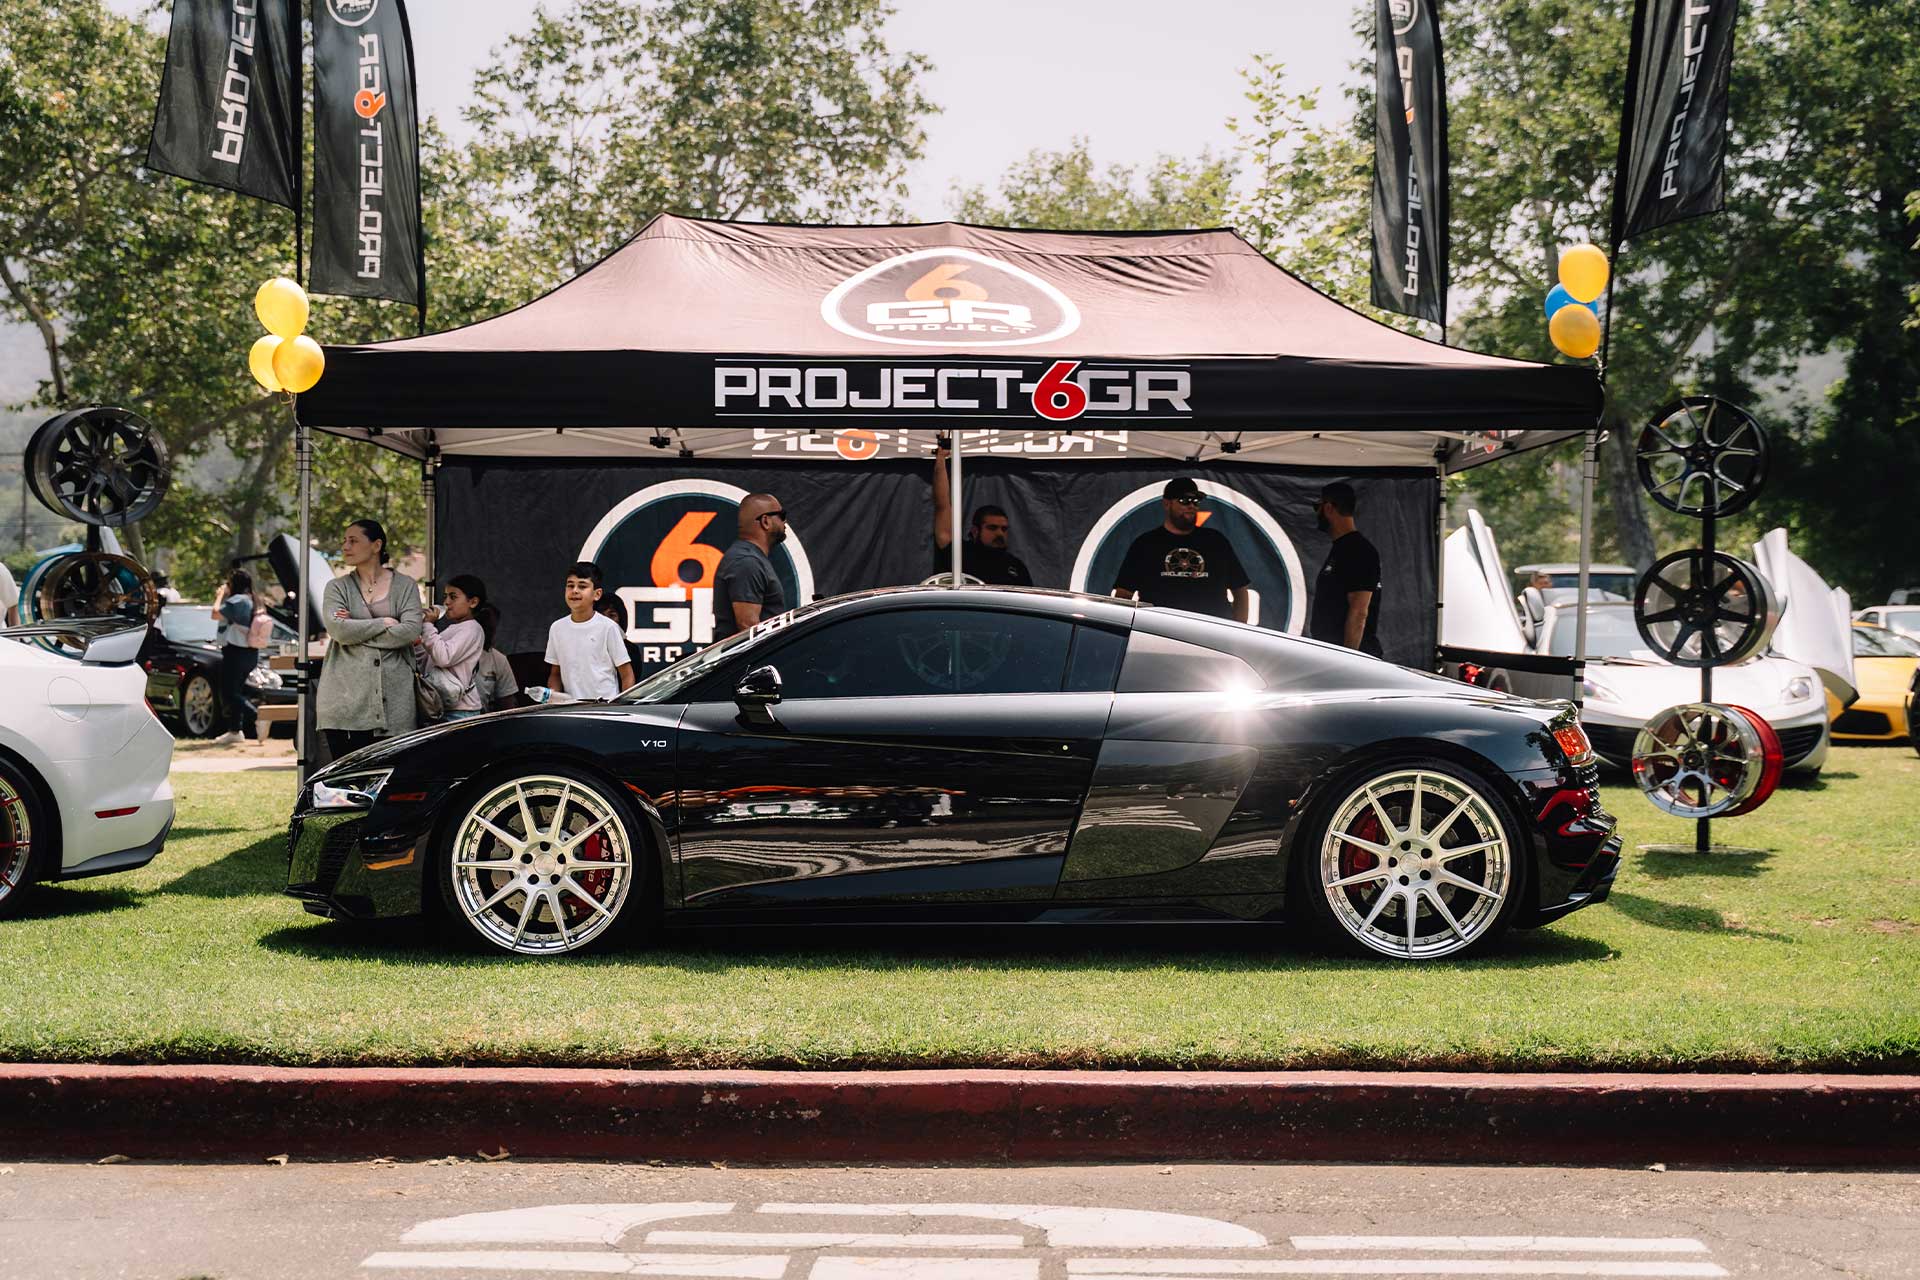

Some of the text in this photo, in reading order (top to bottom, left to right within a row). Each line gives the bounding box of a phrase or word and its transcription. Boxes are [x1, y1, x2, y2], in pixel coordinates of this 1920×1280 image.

[866, 300, 1037, 328] GR
[875, 323, 1033, 334] PROJECT
[714, 361, 1192, 421] PROJECT-6GR
[651, 511, 725, 601] 6
[640, 740, 667, 748] V10
